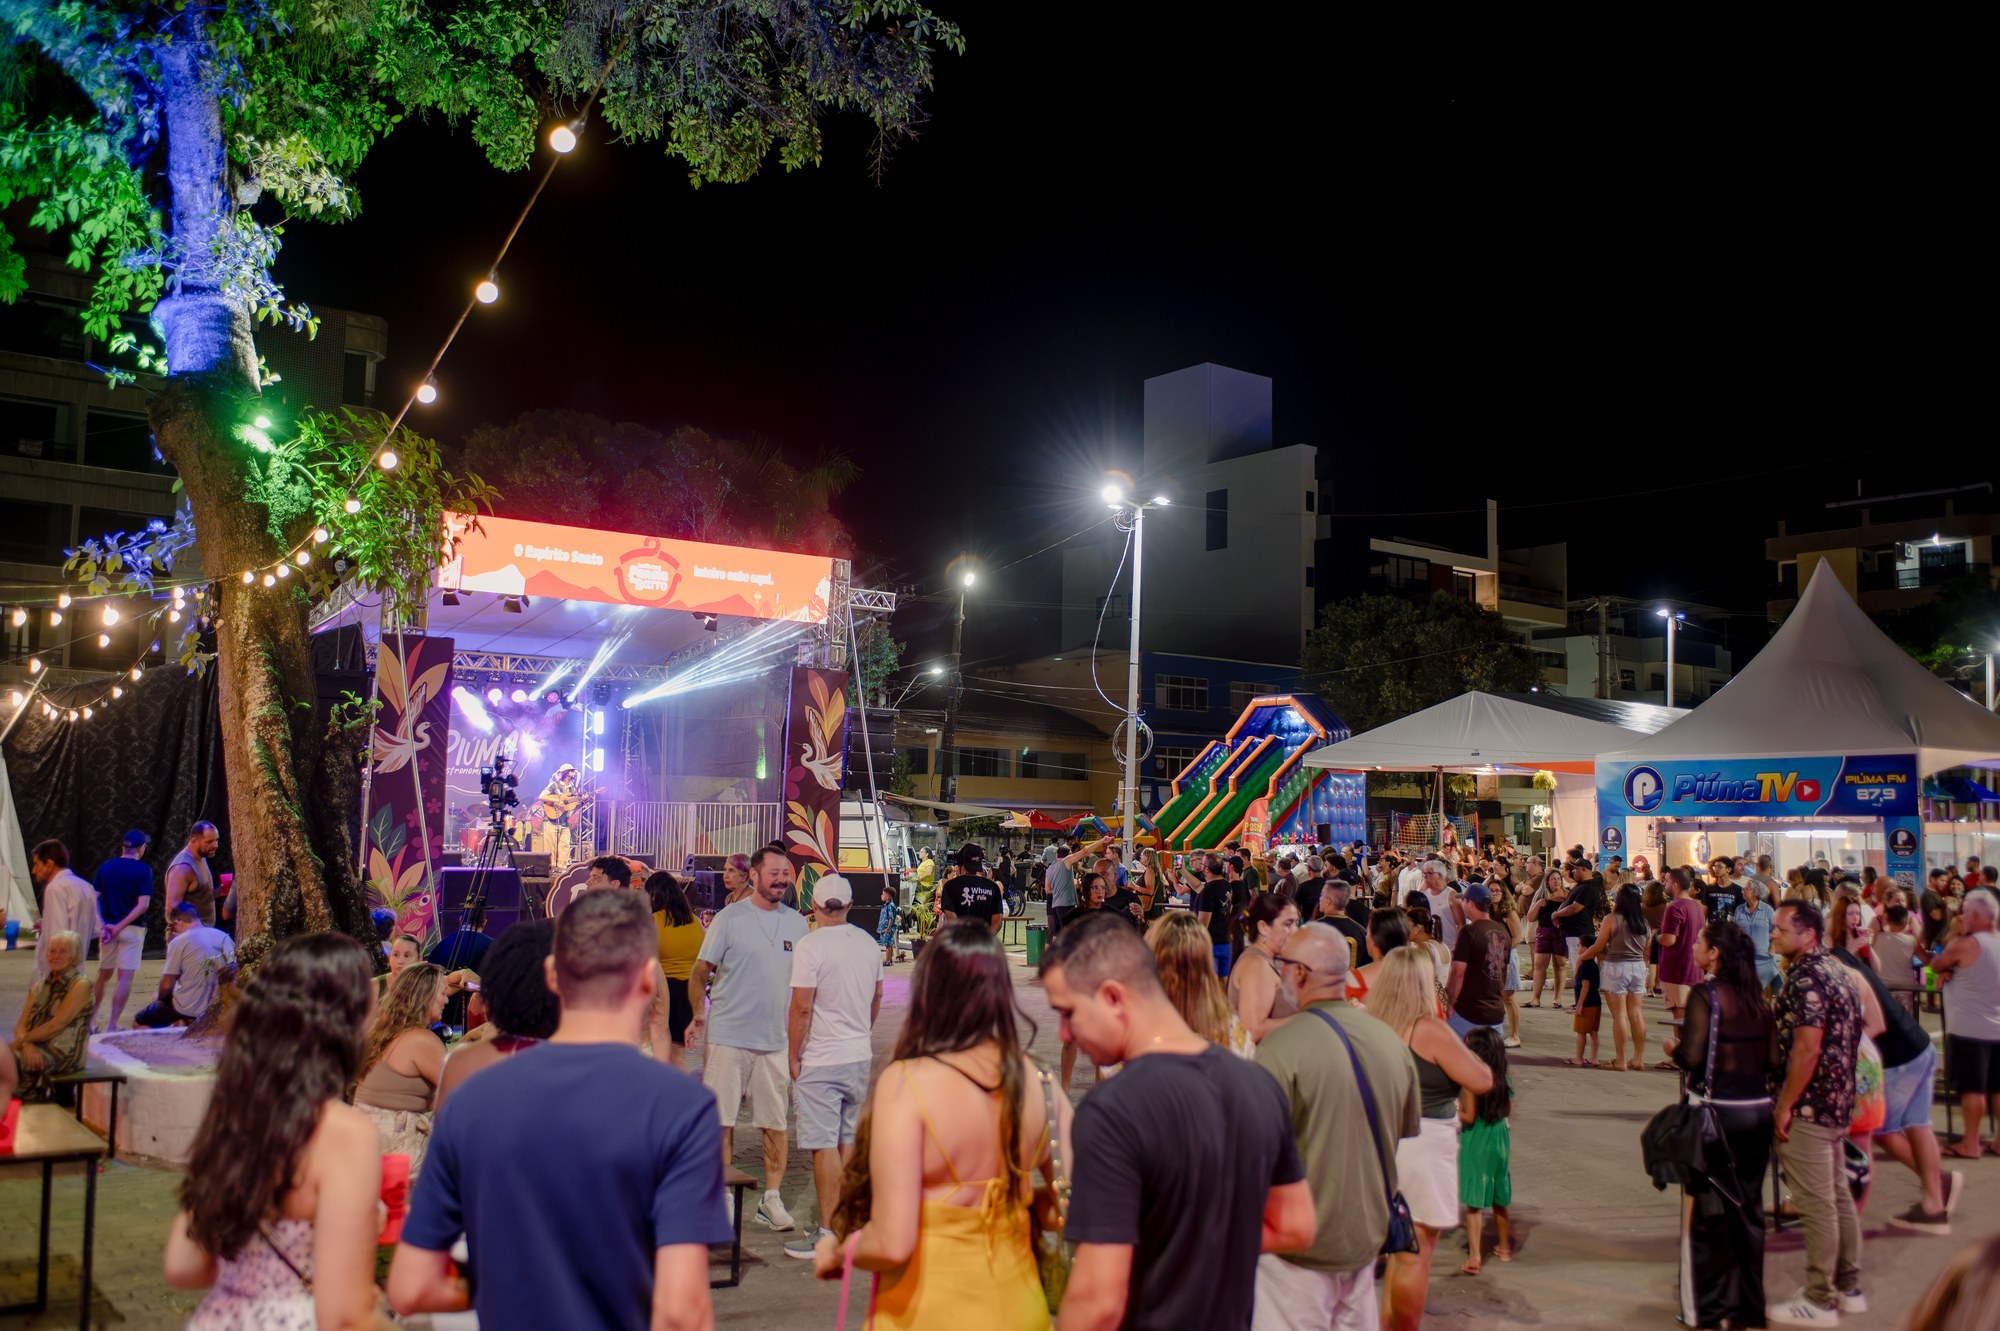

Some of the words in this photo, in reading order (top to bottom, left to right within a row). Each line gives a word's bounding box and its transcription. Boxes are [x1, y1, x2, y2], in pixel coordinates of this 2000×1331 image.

[514, 543, 523, 557] O
[525, 544, 570, 562] Espírito
[571, 550, 604, 566] Santo
[1845, 772, 1885, 784] PIÚMA
[1887, 774, 1906, 784] FM
[1856, 788, 1897, 803] 87,9
